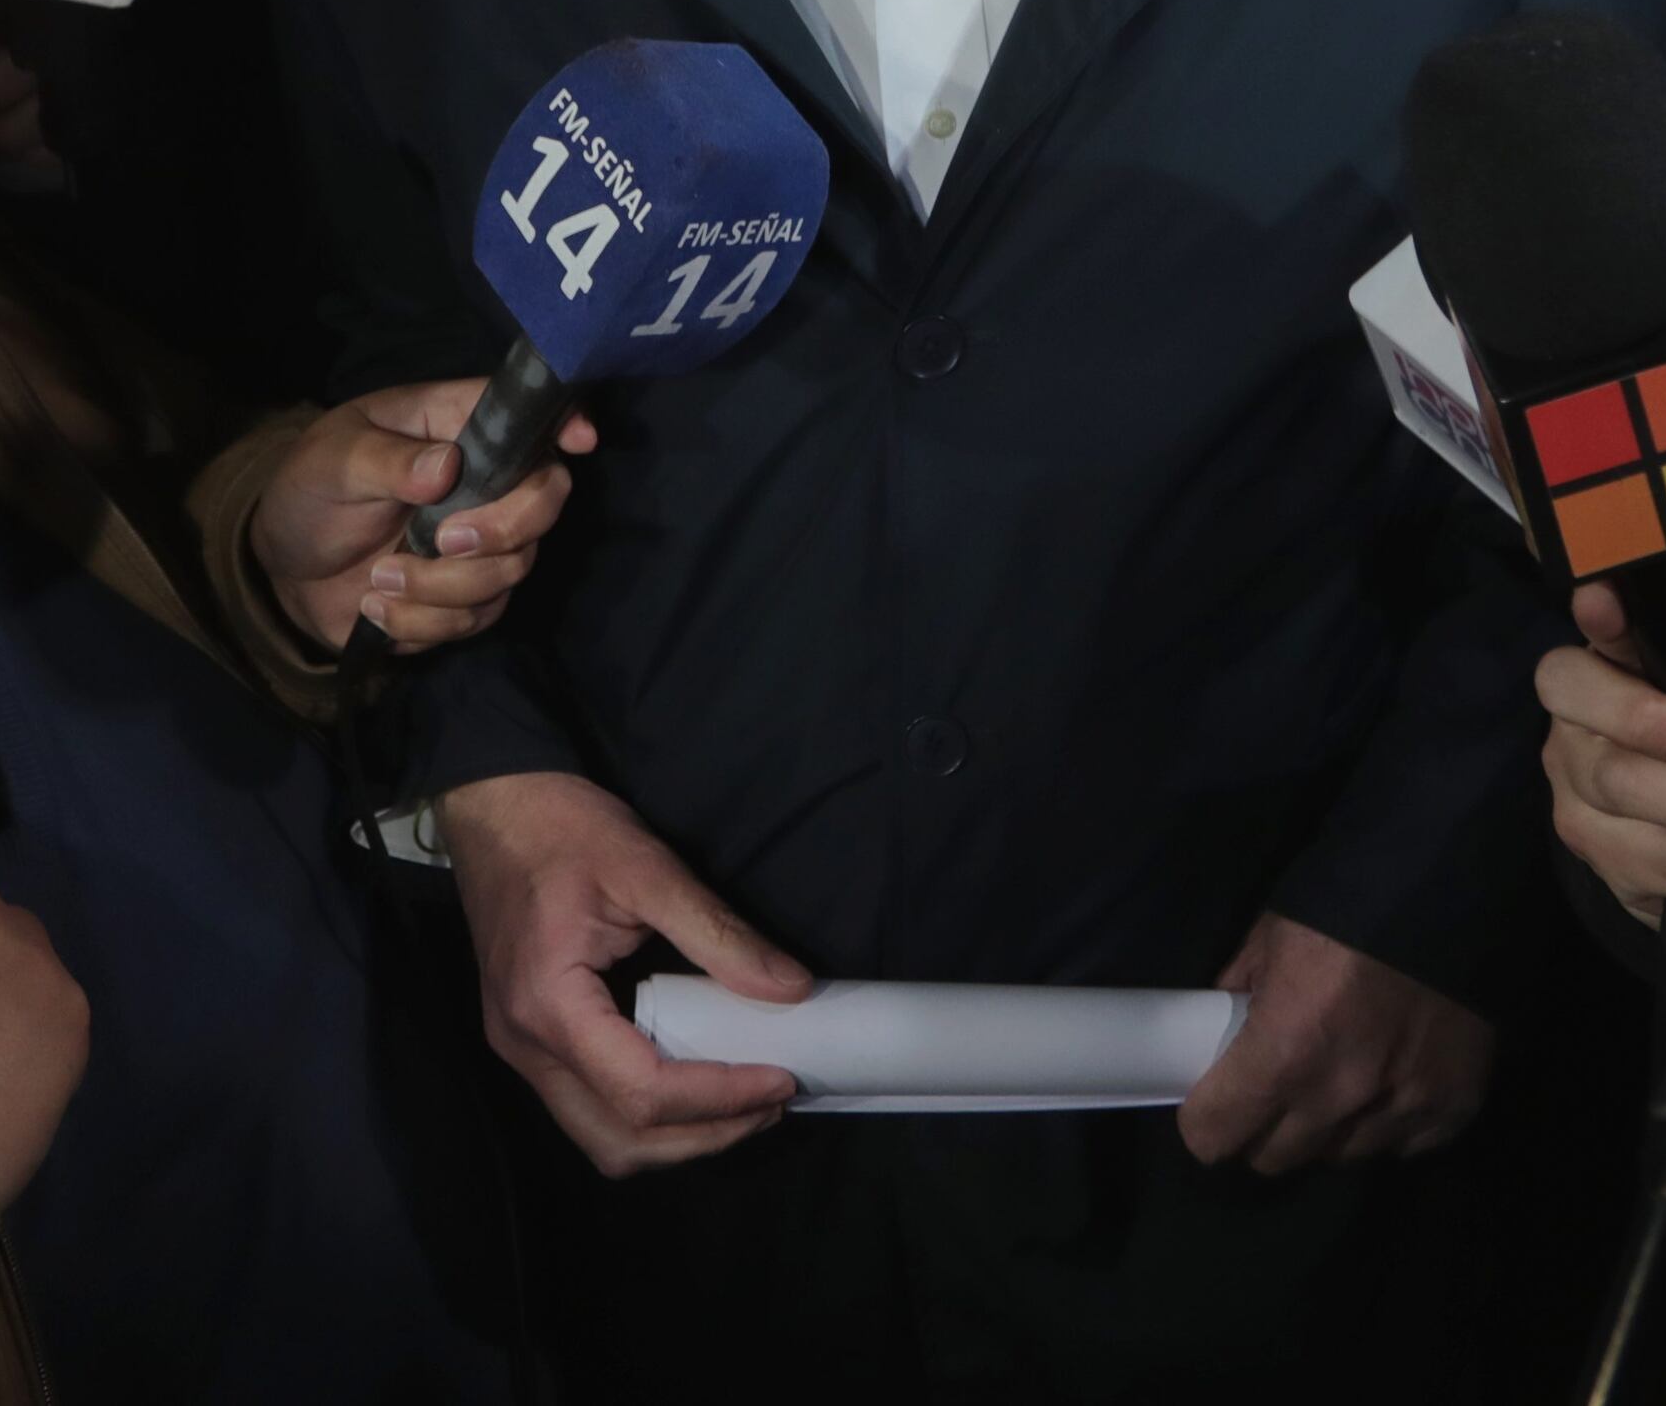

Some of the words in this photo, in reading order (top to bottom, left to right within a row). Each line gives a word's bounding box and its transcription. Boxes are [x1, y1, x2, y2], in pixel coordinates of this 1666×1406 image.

[500, 135, 621, 301] 14
[548, 88, 652, 234] FM-SEÑAL
[677, 211, 805, 249] FM-SEÑAL
[630, 250, 779, 338] 14
